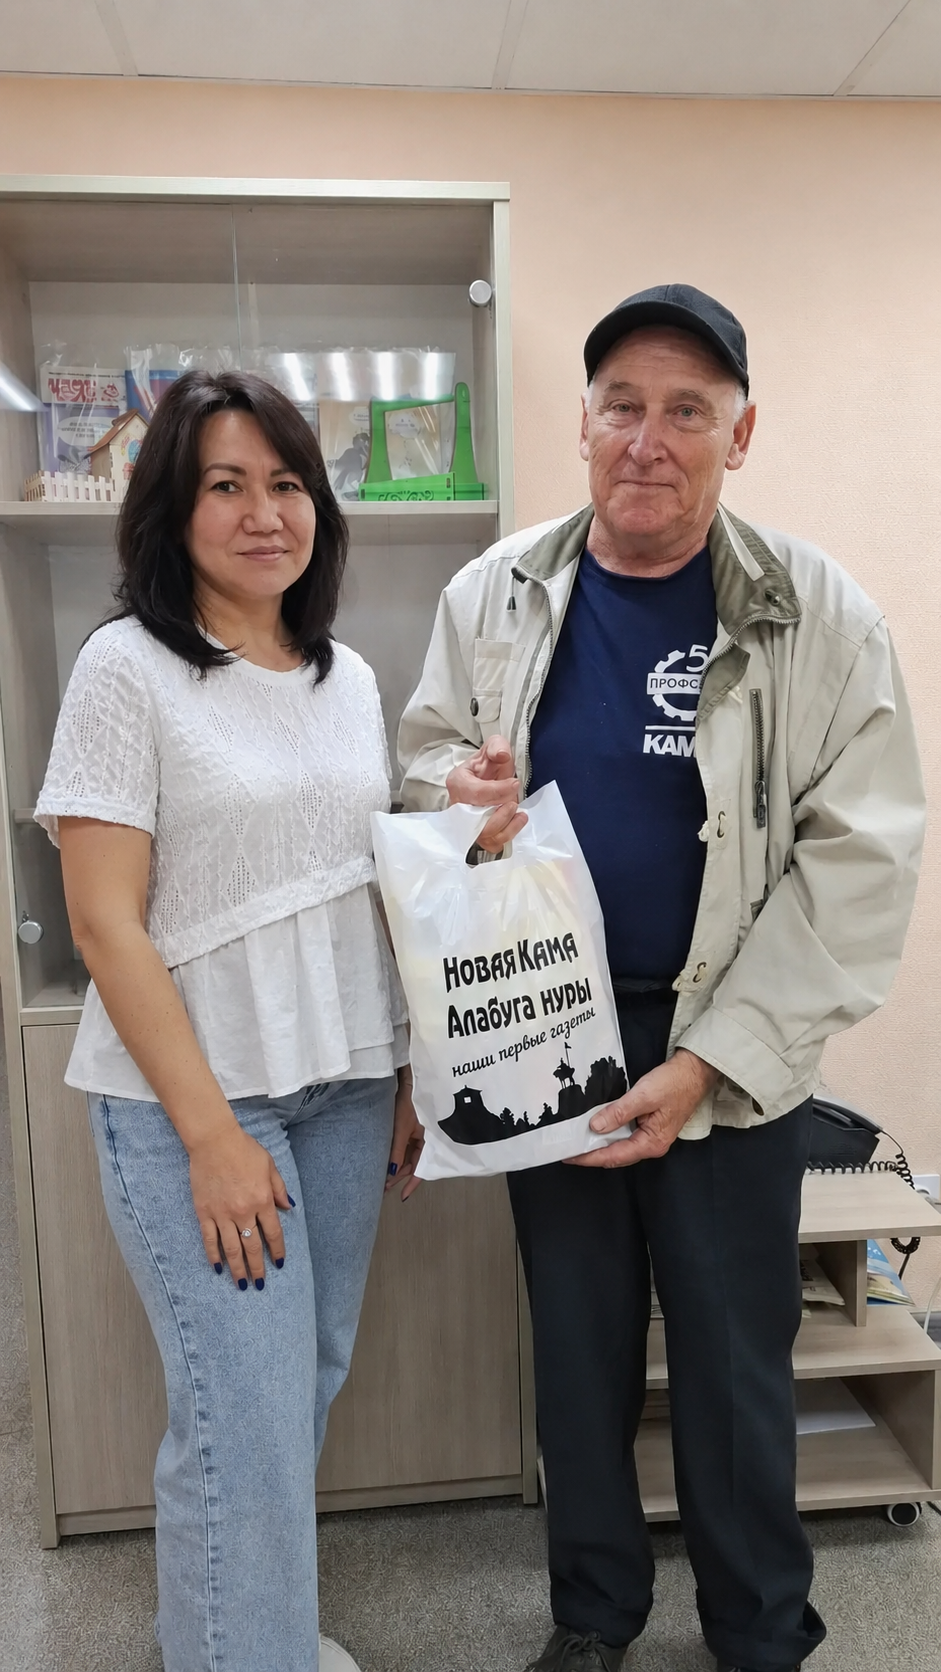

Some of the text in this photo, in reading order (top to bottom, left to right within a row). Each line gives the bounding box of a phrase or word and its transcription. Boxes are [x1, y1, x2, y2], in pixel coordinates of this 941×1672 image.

[448, 977, 592, 1039] Алабуга нуры
[452, 1007, 597, 1078] наши первые газеты
